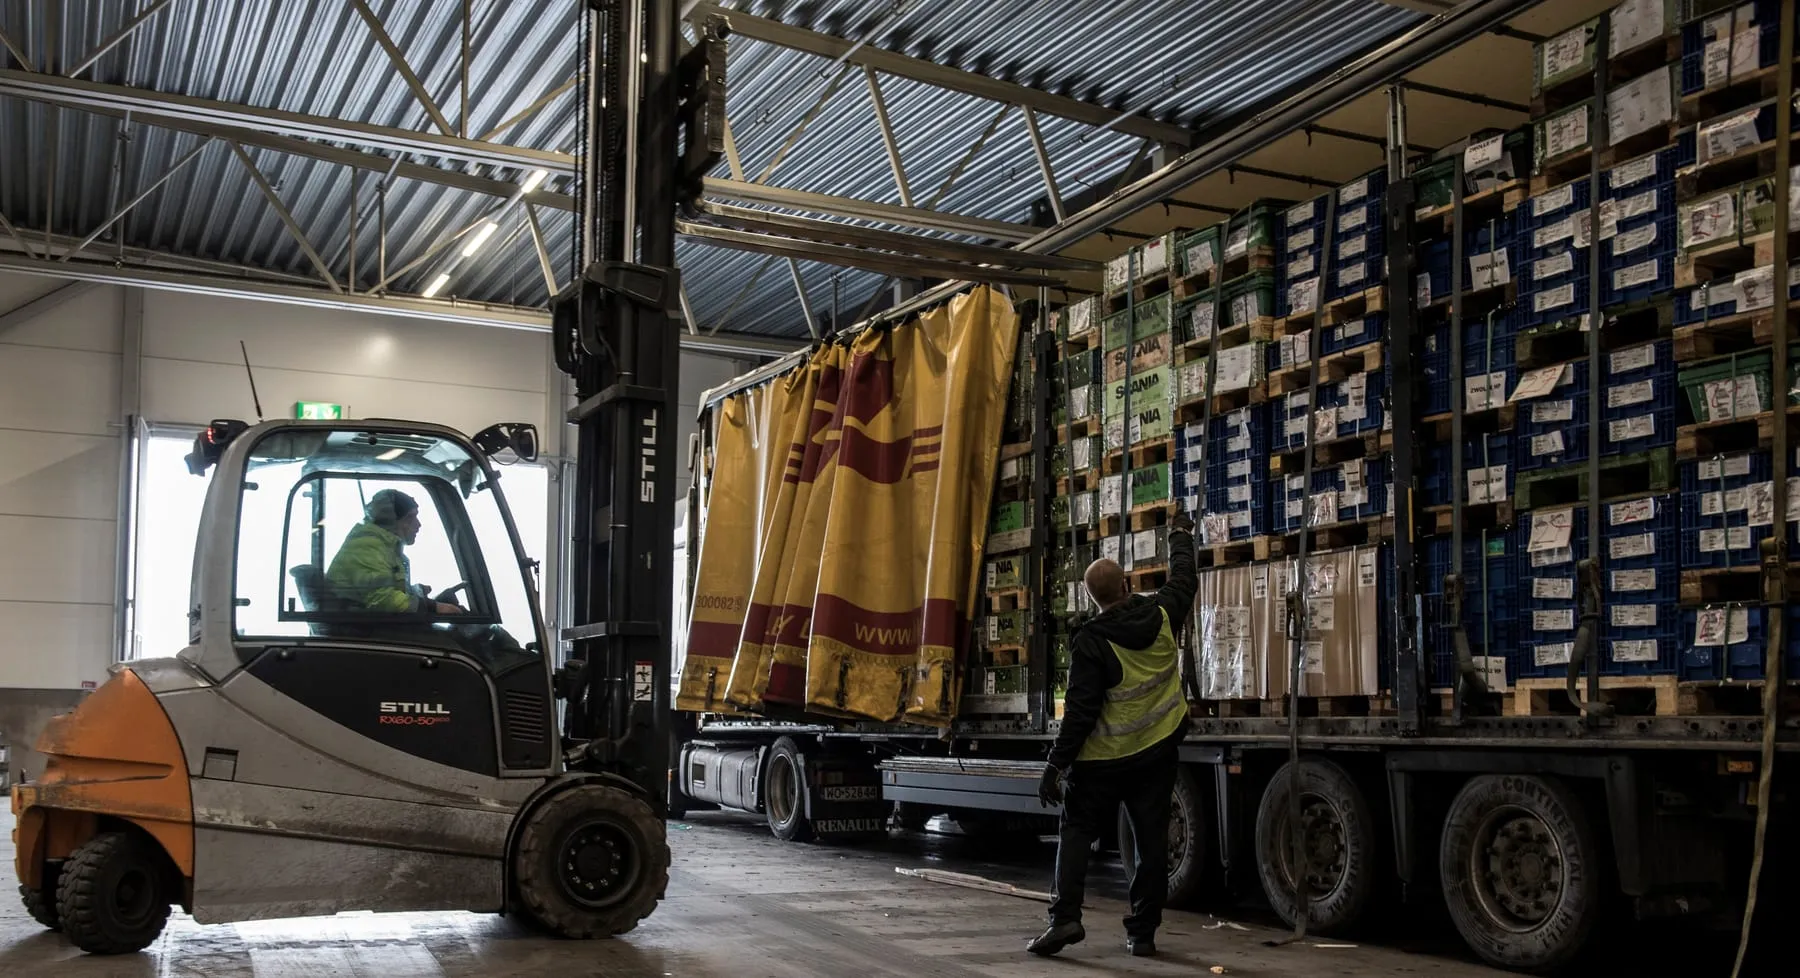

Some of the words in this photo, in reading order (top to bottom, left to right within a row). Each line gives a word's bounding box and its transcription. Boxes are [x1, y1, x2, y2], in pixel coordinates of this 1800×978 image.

[1116, 373, 1159, 399] SANIA
[1470, 384, 1492, 394] ZWOLE
[1139, 408, 1160, 426] NIA
[641, 408, 657, 503] STILL
[996, 560, 1013, 574] NIA
[380, 702, 450, 715] STILL
[816, 818, 880, 832] RENAULT
[1502, 776, 1582, 887] CONTINENTAL
